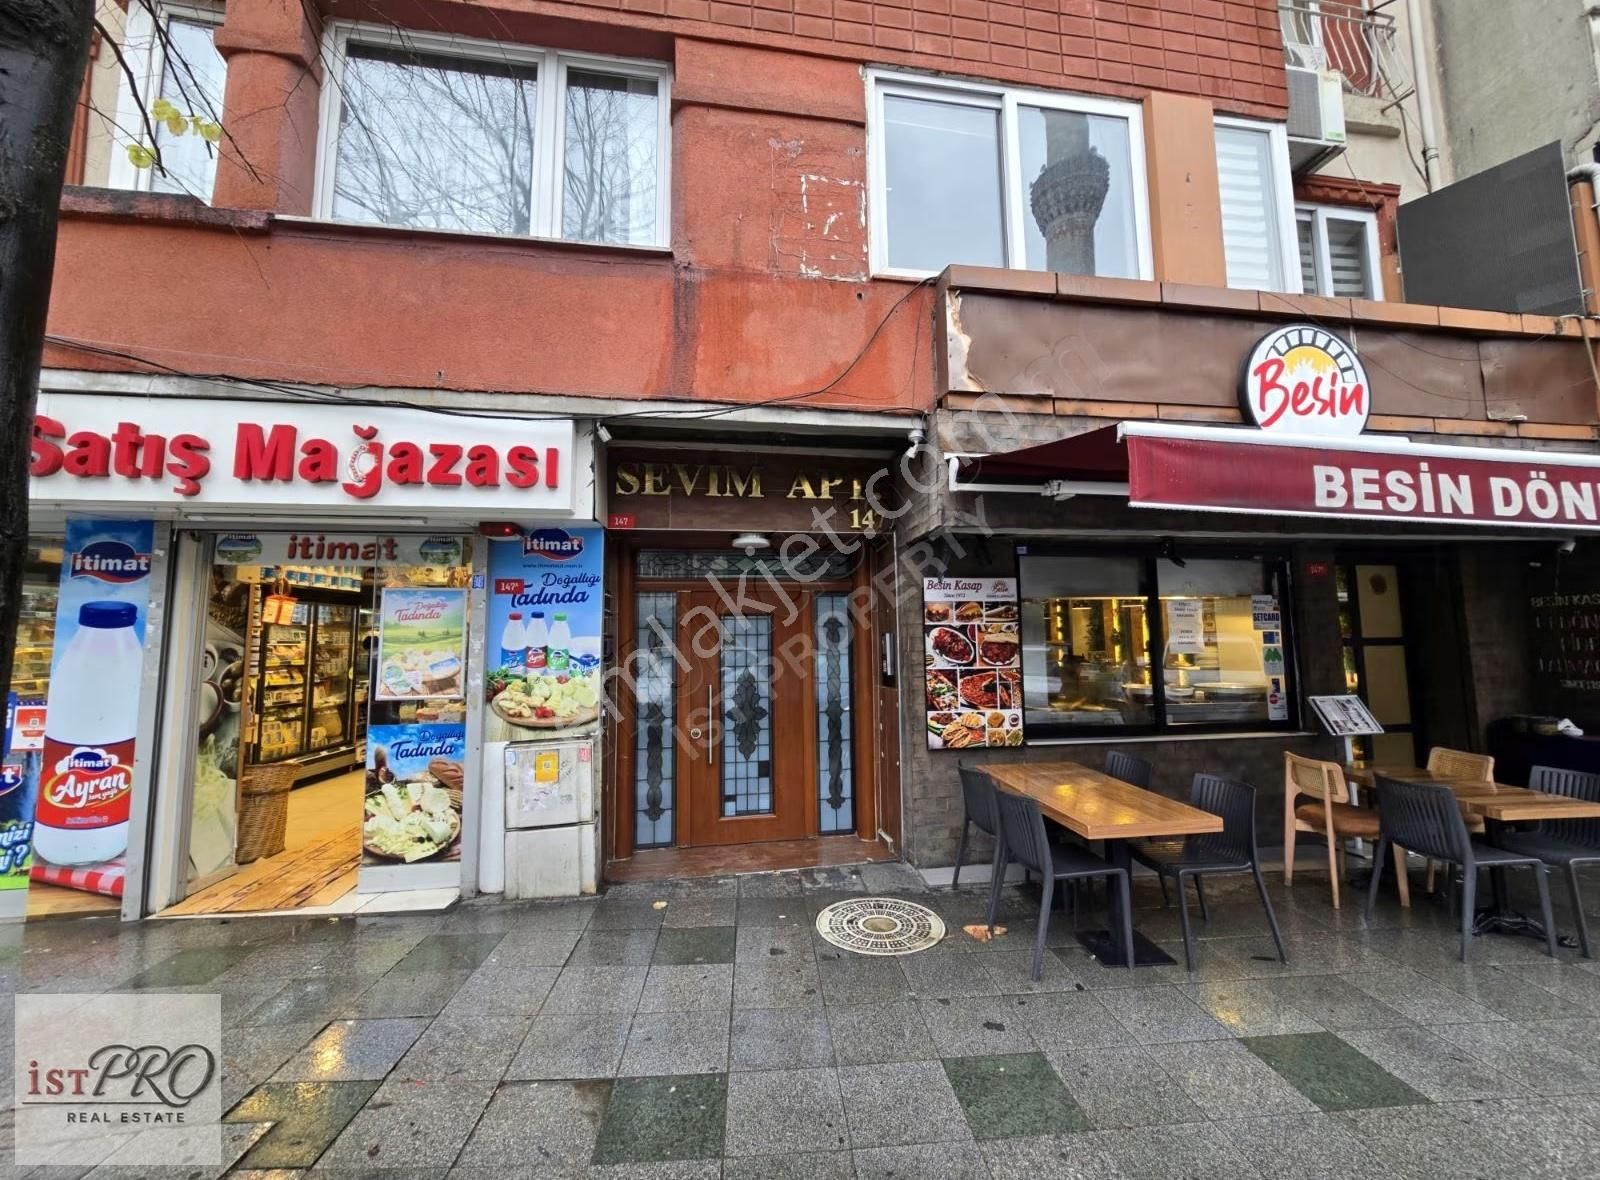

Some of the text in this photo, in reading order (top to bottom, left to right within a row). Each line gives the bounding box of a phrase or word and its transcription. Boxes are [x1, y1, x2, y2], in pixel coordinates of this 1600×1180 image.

[1254, 356, 1364, 428] Besin
[30, 415, 559, 499] Satış Mağazası
[615, 462, 764, 498] SEVIM
[1313, 462, 1600, 521] BESİN DÖN
[615, 516, 629, 526] 147
[287, 533, 398, 561] itimat
[526, 537, 581, 551] itimat
[74, 554, 149, 571] itimat
[395, 607, 442, 622] Tadında
[69, 757, 110, 768] itimat
[390, 740, 458, 761] Tadında
[51, 772, 130, 809] Ayran
